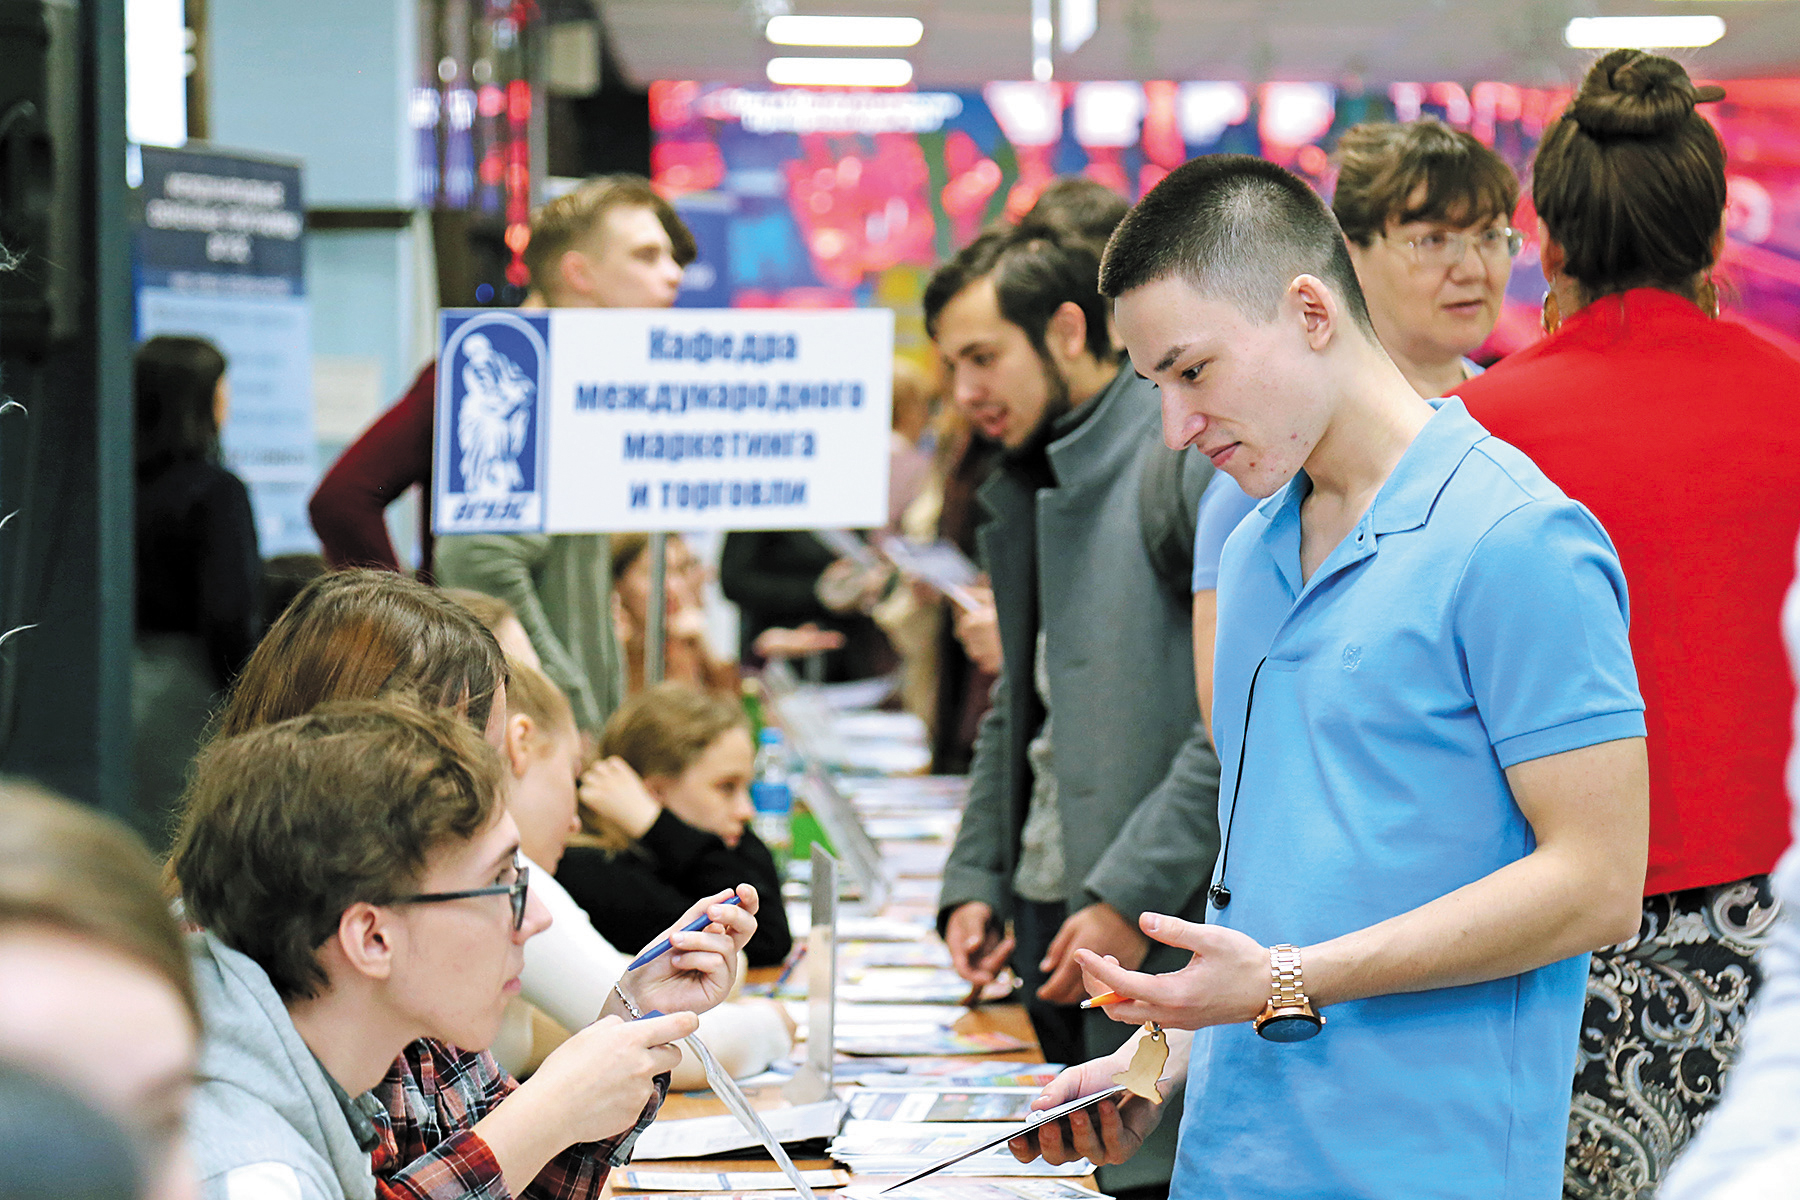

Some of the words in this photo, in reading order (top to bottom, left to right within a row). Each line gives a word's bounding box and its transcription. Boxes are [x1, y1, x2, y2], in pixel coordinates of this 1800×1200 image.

[648, 327, 799, 366] Кафедра
[574, 380, 865, 415] международного
[623, 430, 816, 464] маркетинга
[629, 480, 650, 510] и
[660, 479, 808, 512] торговли
